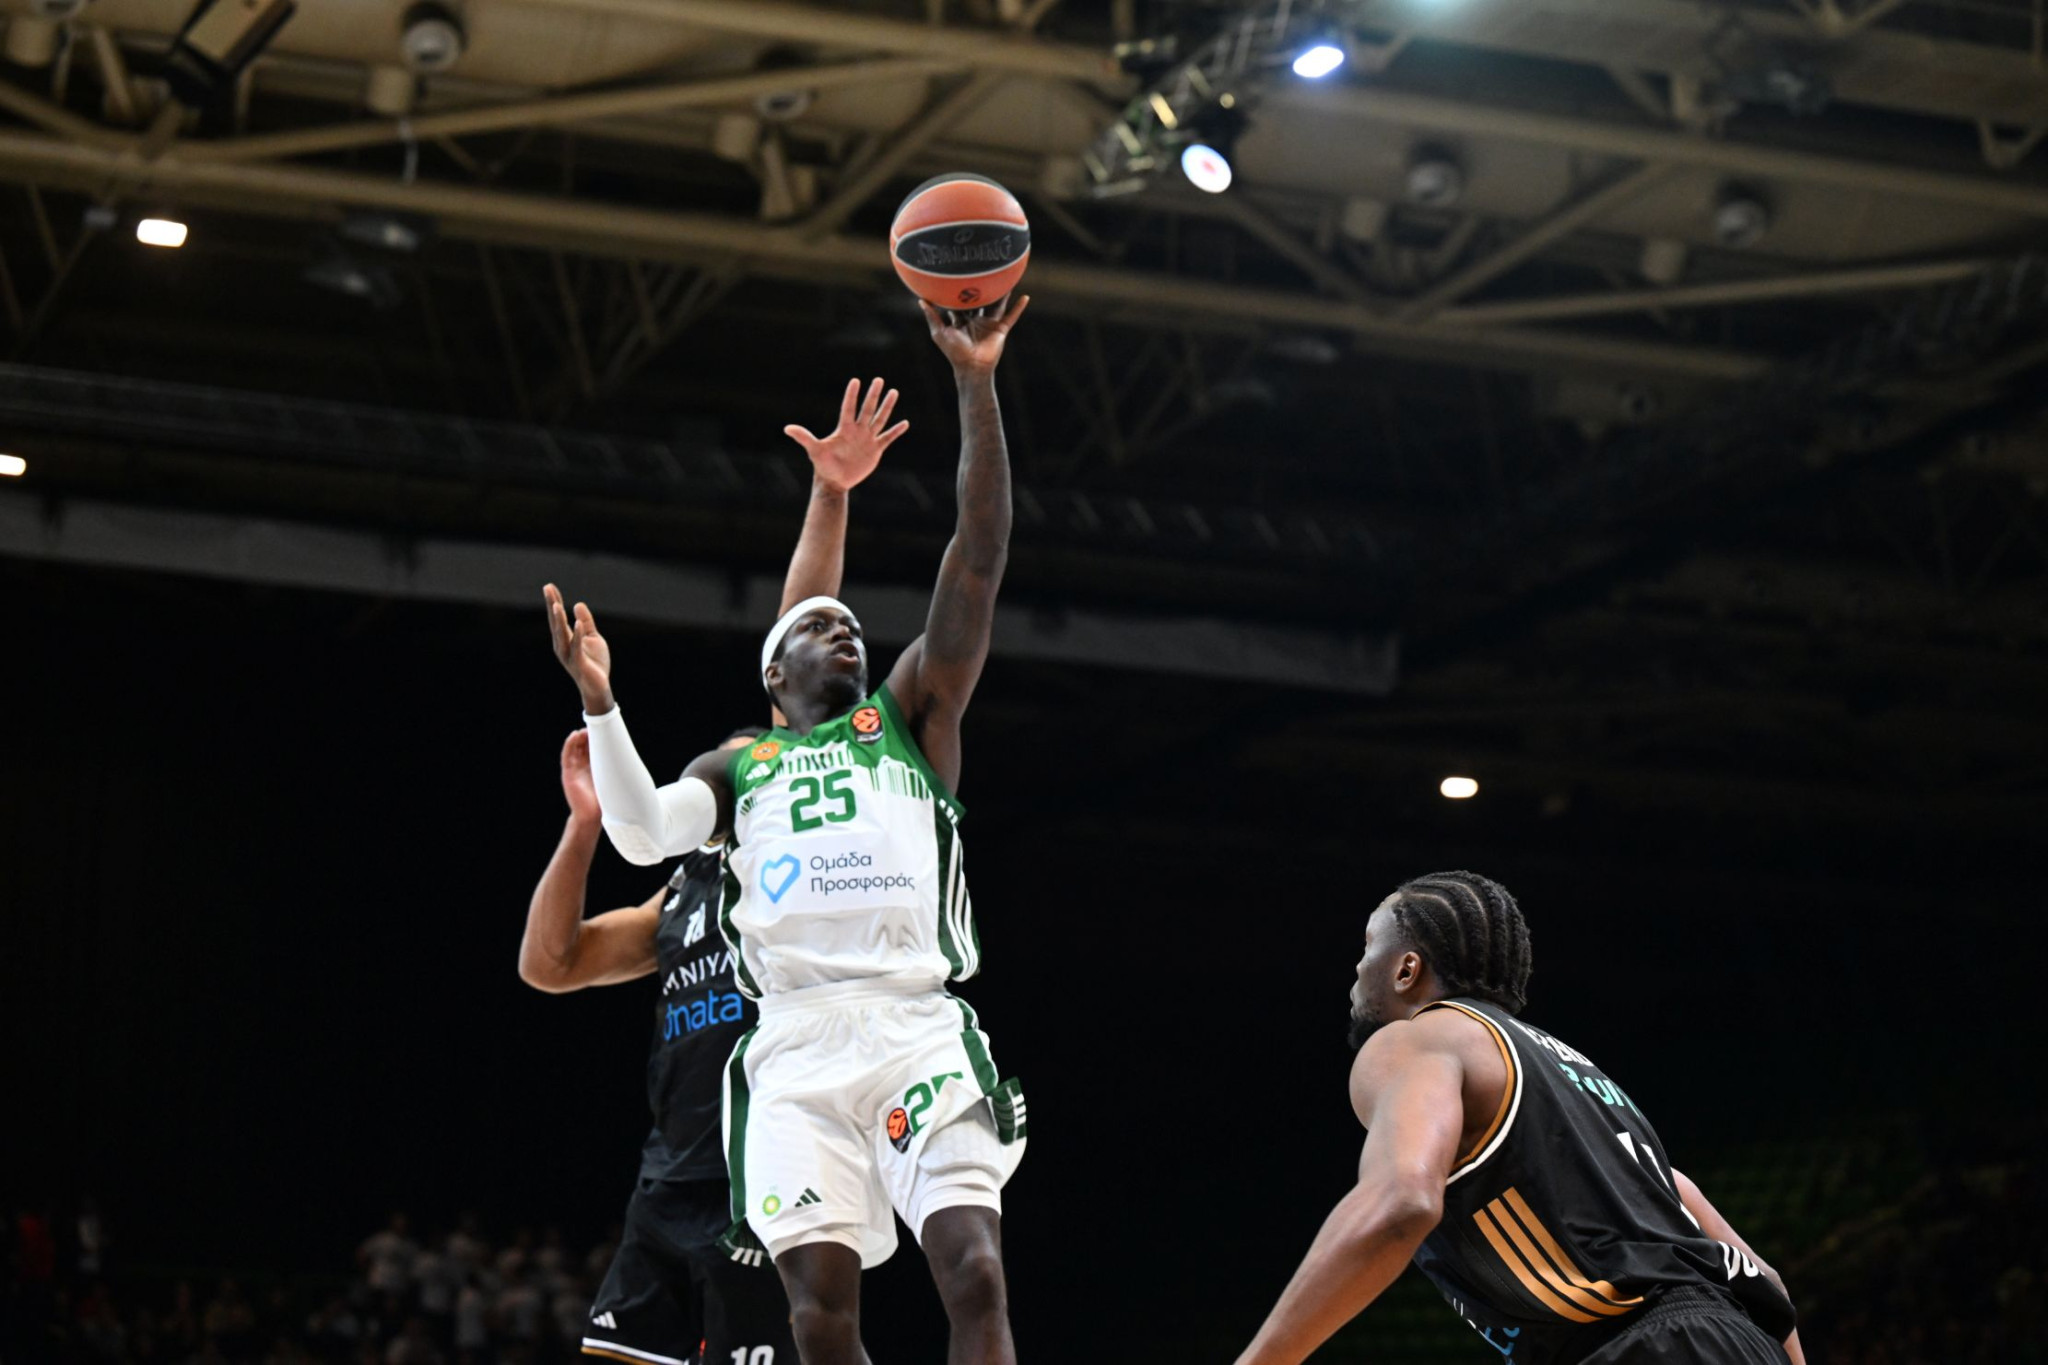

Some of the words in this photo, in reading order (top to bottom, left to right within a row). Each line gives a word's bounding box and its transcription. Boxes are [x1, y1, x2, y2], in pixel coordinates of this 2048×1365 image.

[917, 234, 1012, 266] SPALDING
[788, 769, 857, 833] 25
[810, 851, 872, 874] Ομάδα
[810, 867, 915, 893] Προσφοράς
